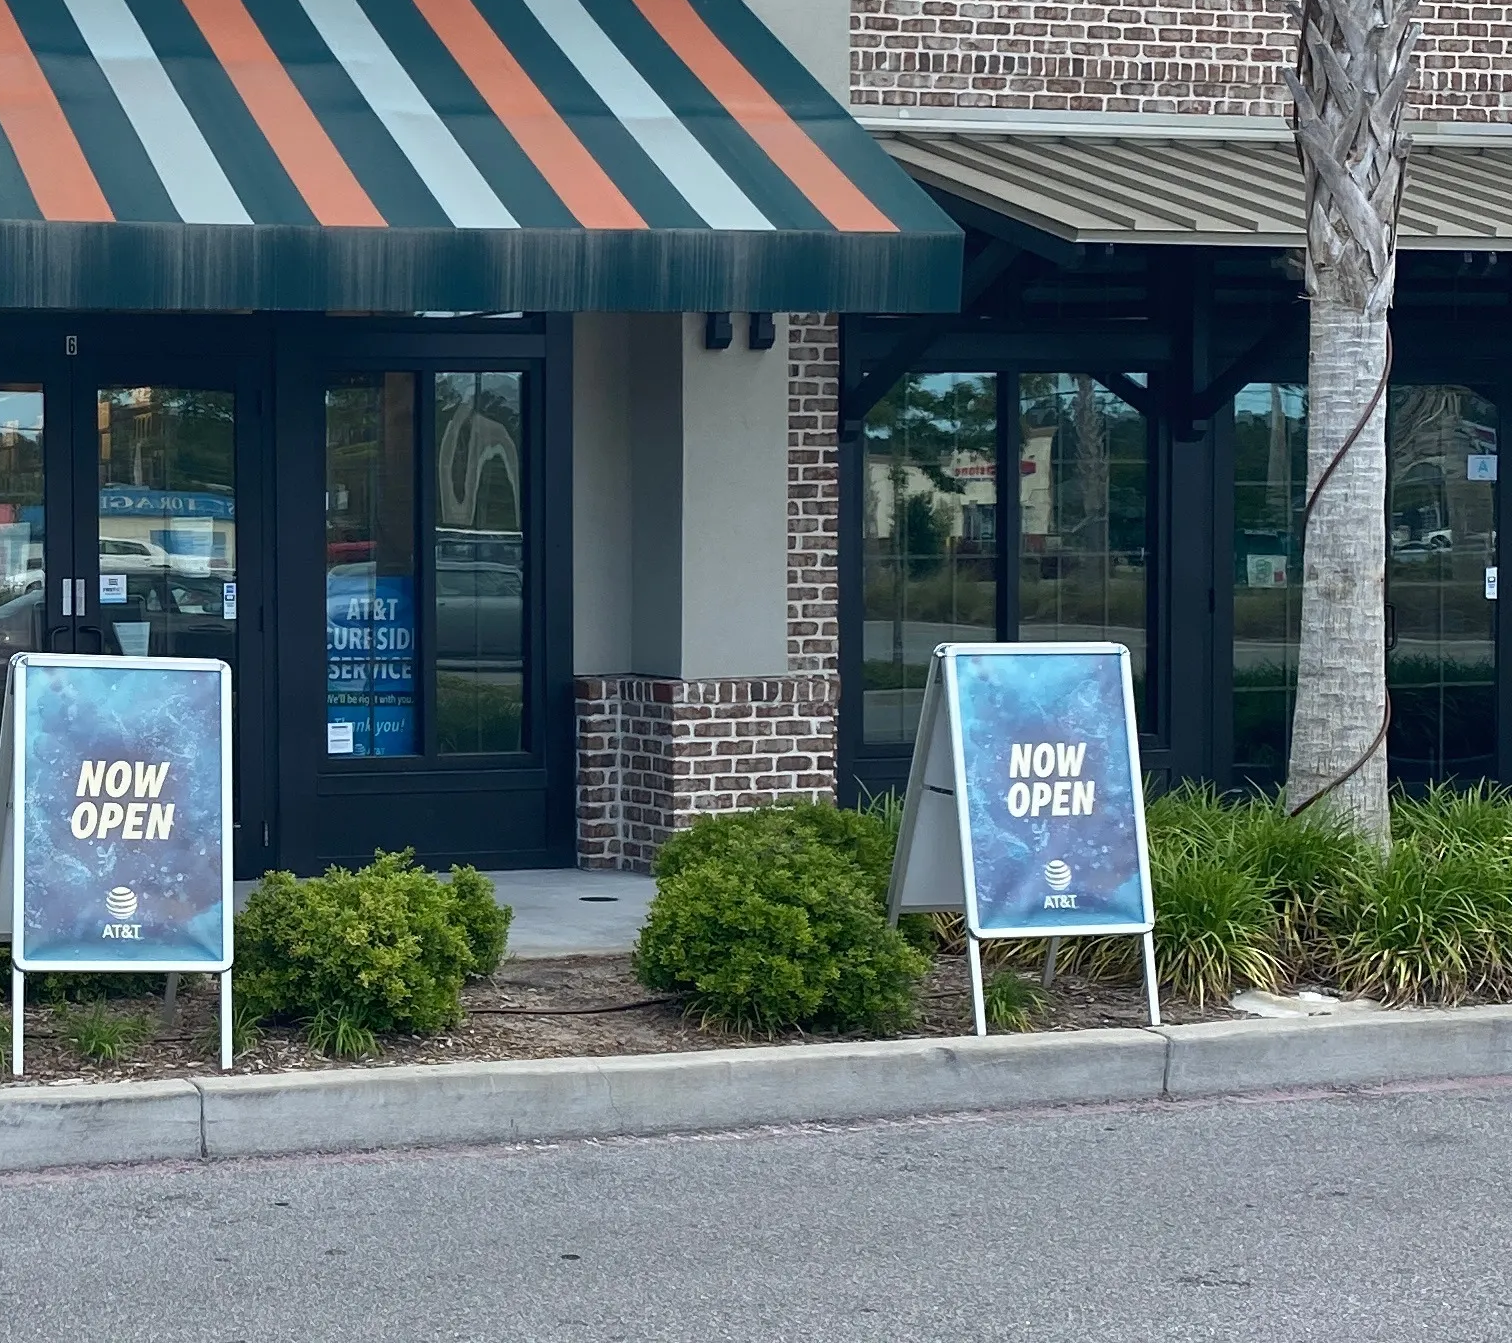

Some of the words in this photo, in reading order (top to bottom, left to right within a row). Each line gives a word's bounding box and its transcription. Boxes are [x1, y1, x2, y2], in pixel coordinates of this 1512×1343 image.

[68, 337, 76, 354] 6
[346, 598, 399, 621] AT&T
[347, 694, 357, 704] be
[358, 694, 378, 707] rigt
[379, 694, 396, 704] with
[374, 718, 405, 737] you!
[1009, 741, 1087, 778] NOW
[76, 760, 171, 799] NOW
[1007, 780, 1095, 818] OPEN
[70, 802, 175, 841] OPEN
[1043, 893, 1079, 910] AT&T
[102, 923, 142, 939] AT&T
